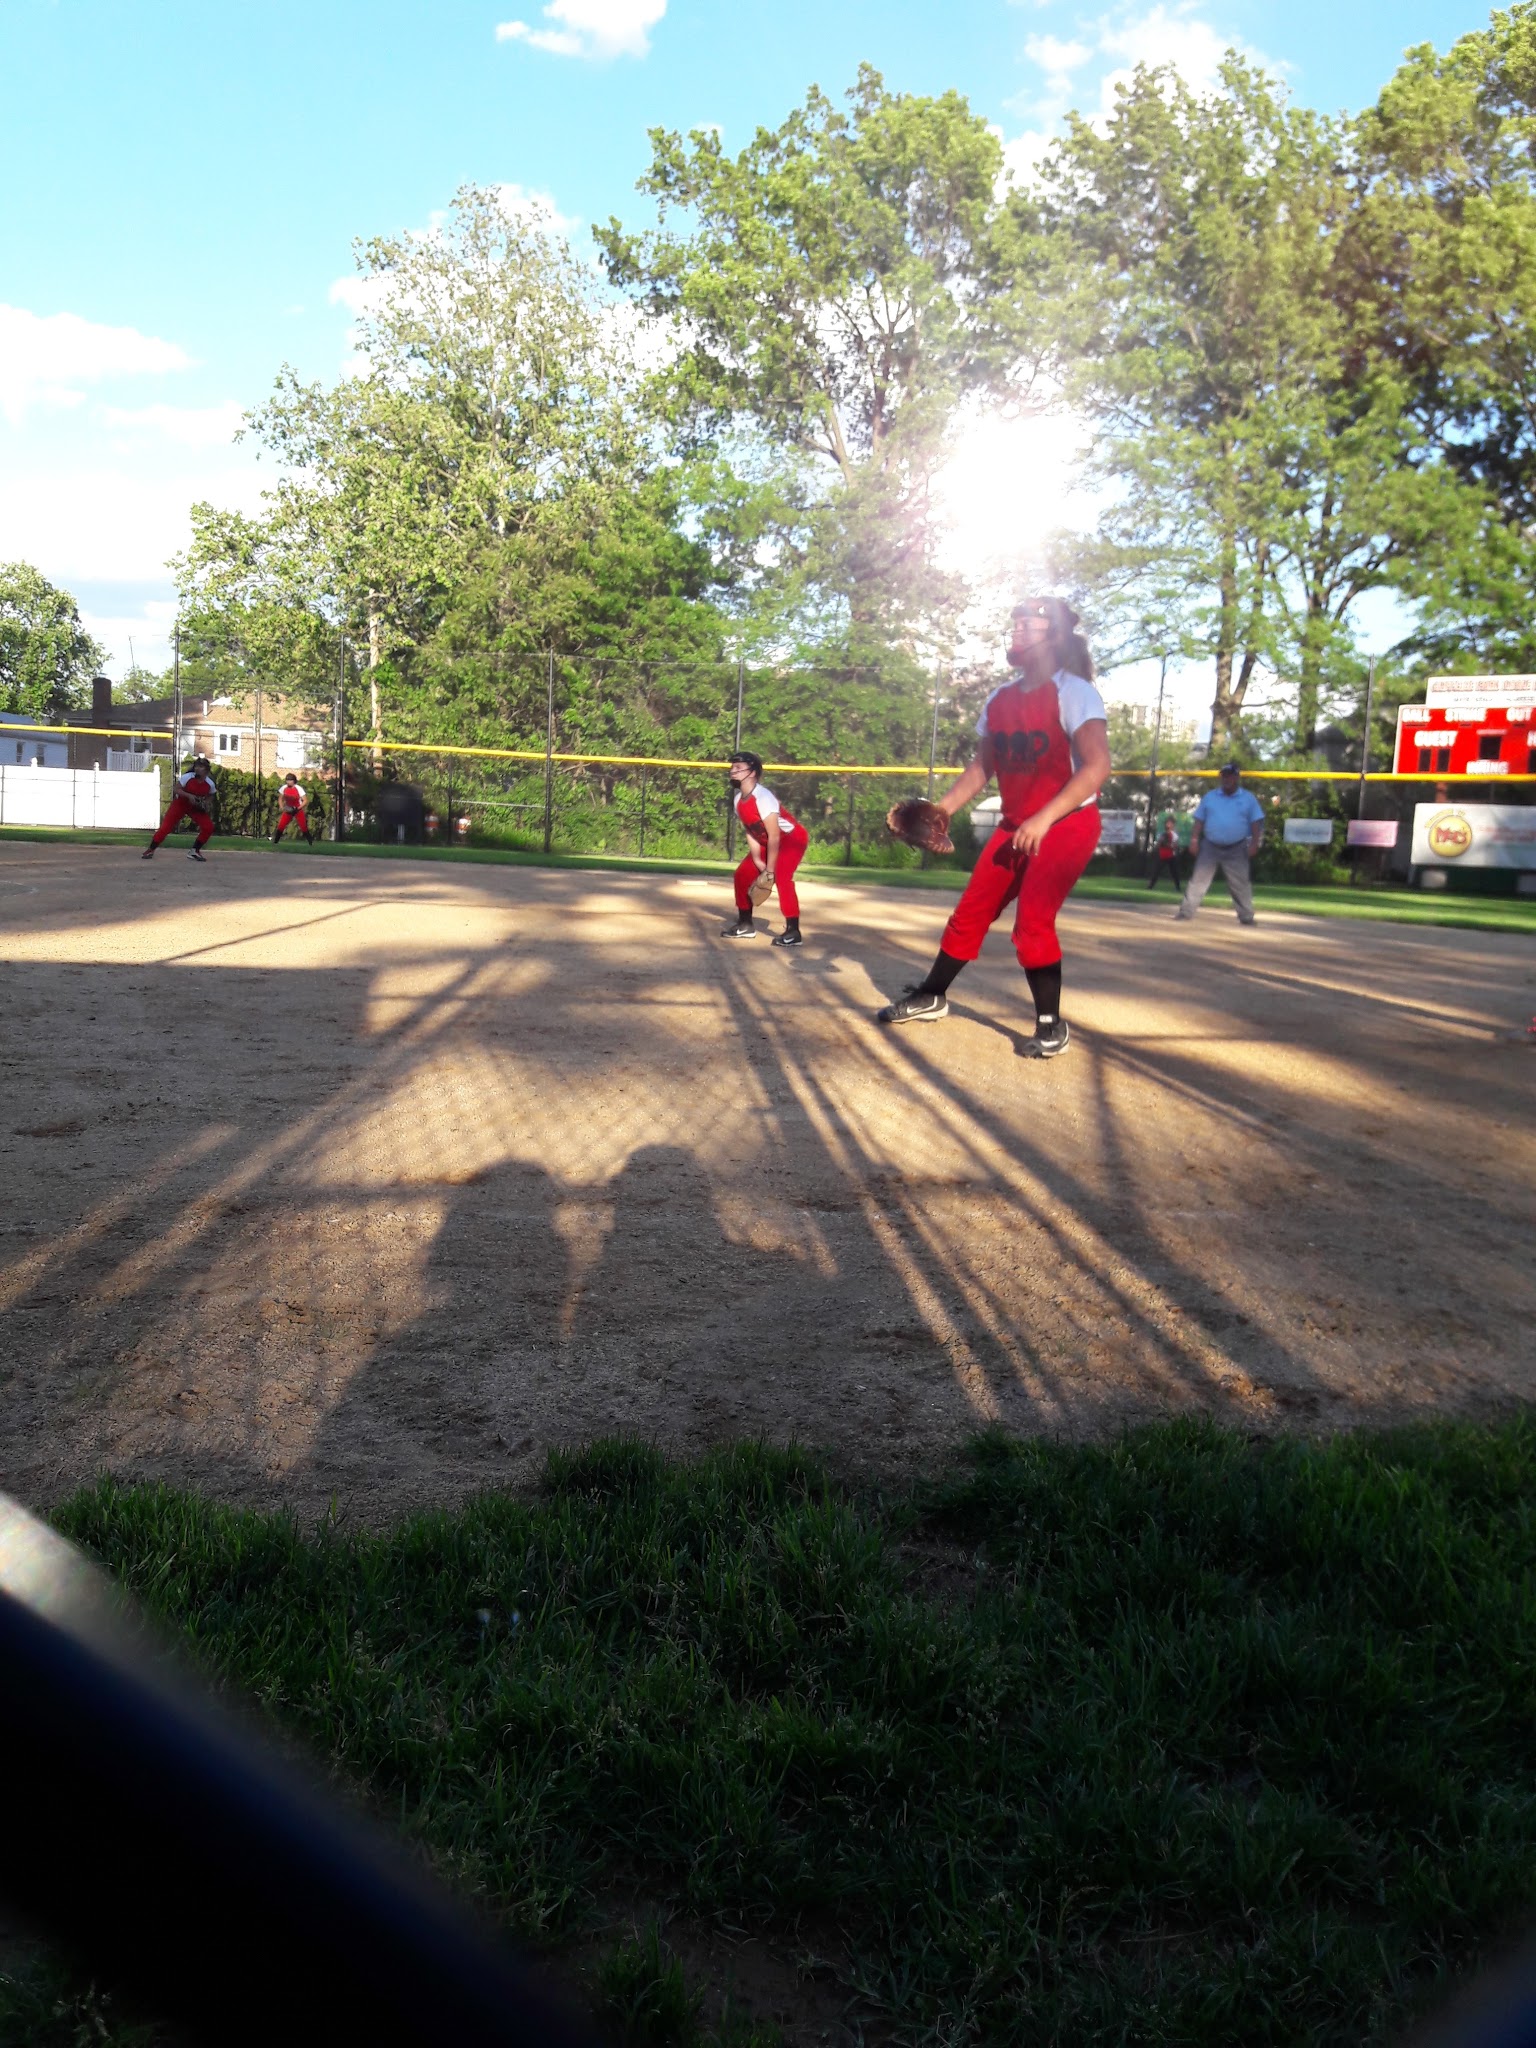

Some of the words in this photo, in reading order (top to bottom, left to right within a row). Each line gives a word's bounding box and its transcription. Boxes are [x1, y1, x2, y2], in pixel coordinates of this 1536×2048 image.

[1445, 708, 1486, 722] STRIKE
[1507, 707, 1532, 721] OUT
[1414, 730, 1458, 747] GUEST
